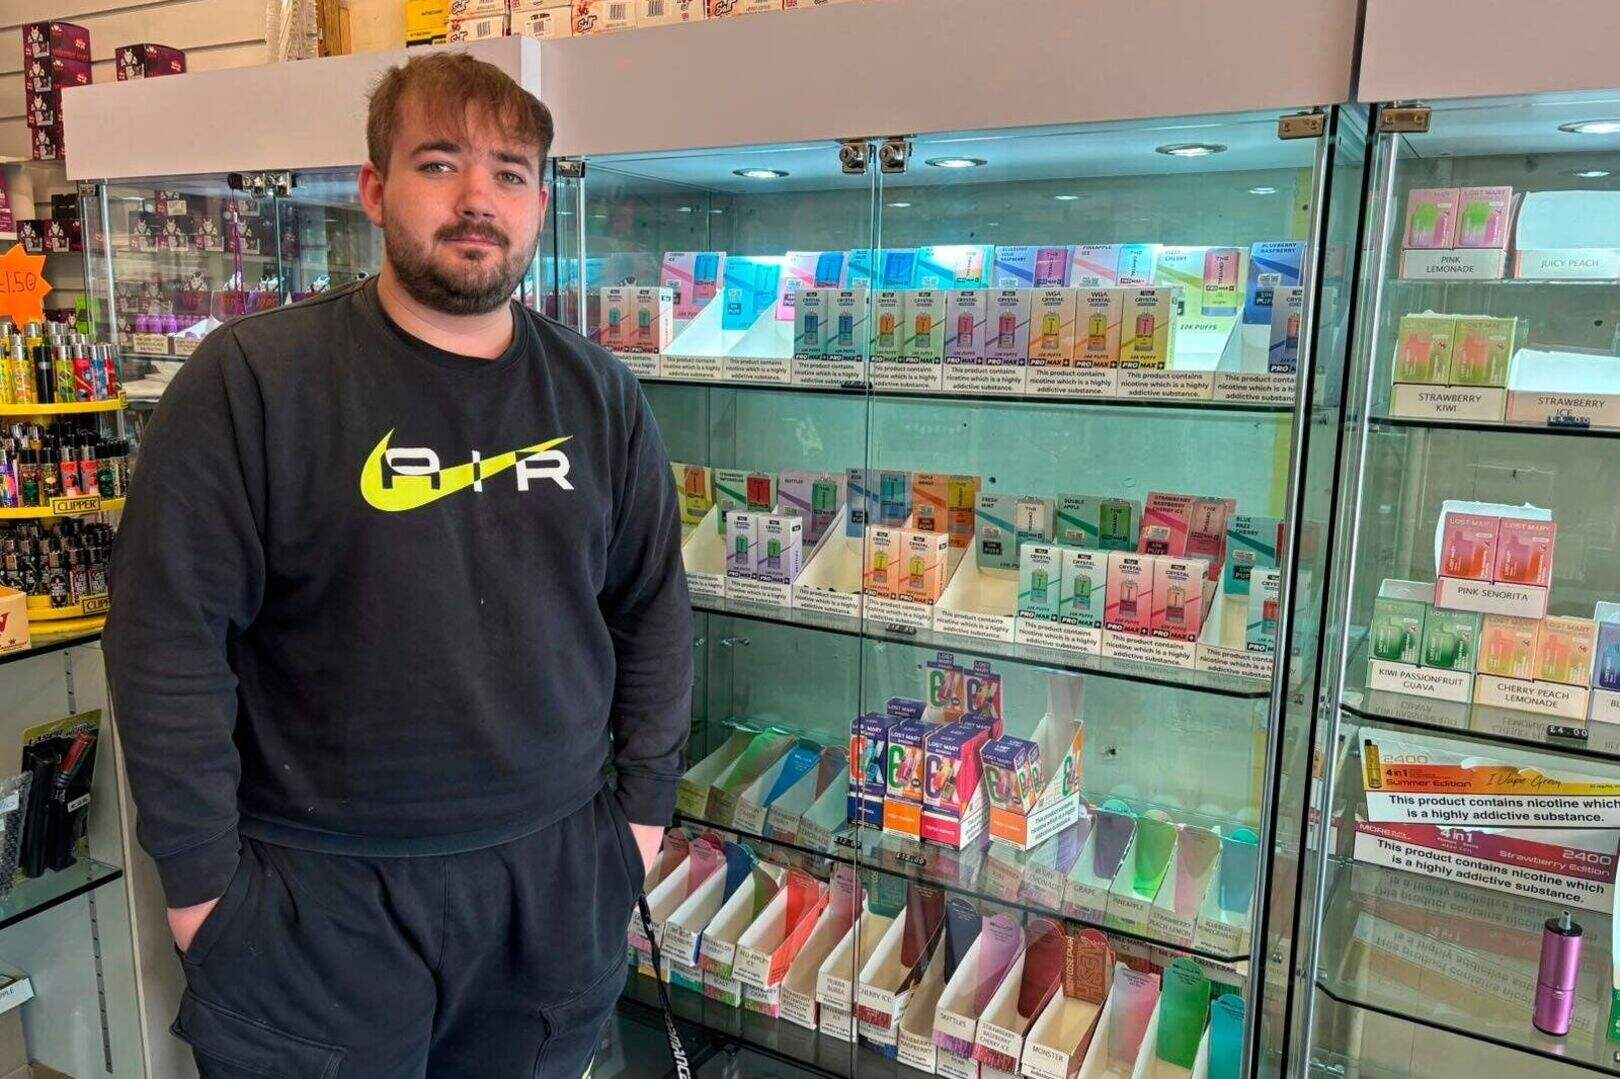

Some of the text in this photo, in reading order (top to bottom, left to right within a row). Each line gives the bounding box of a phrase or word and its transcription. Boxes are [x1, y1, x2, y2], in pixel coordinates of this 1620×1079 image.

[1426, 265, 1474, 273] LEMONADE
[1541, 259, 1599, 268] JUICY PEACH
[1122, 361, 1138, 369] PRO
[1143, 373, 1171, 381] product
[1187, 382, 1208, 390] highly
[1418, 393, 1482, 403] STRAWBERRY
[1538, 396, 1605, 408] STRAWBERRY
[1436, 404, 1457, 412] KIWI
[381, 447, 575, 492] AIR
[57, 500, 96, 511] CLIPPER
[1457, 586, 1529, 602] PINK SENORITA
[86, 600, 110, 611] CLIP
[1062, 617, 1077, 625] PRO
[1249, 643, 1266, 651] PRO
[1378, 668, 1463, 686] KIWI PASSIONFRUIT
[1403, 681, 1435, 692] GUAVA
[1497, 683, 1570, 700] CHERRY PEACH
[1505, 694, 1559, 708] LEMONADE
[905, 733, 921, 741] MARY
[943, 744, 959, 752] MARY
[1384, 754, 1428, 764] 2400
[1385, 779, 1472, 788] Summer Edition
[1389, 795, 1620, 808] This product contains nicotine which
[1407, 808, 1418, 818] is
[1432, 808, 1469, 821] highly
[1472, 809, 1530, 820] addictive
[1534, 810, 1604, 821] substance.
[1562, 849, 1612, 866] 2400
[1377, 838, 1605, 894] This product contains nicotine which
[1499, 850, 1610, 877] Strawberry Edition
[1392, 854, 1584, 903] is a highly addictive substance.
[1074, 885, 1096, 897] GRAPE
[1032, 1044, 1064, 1062] MONSTER
